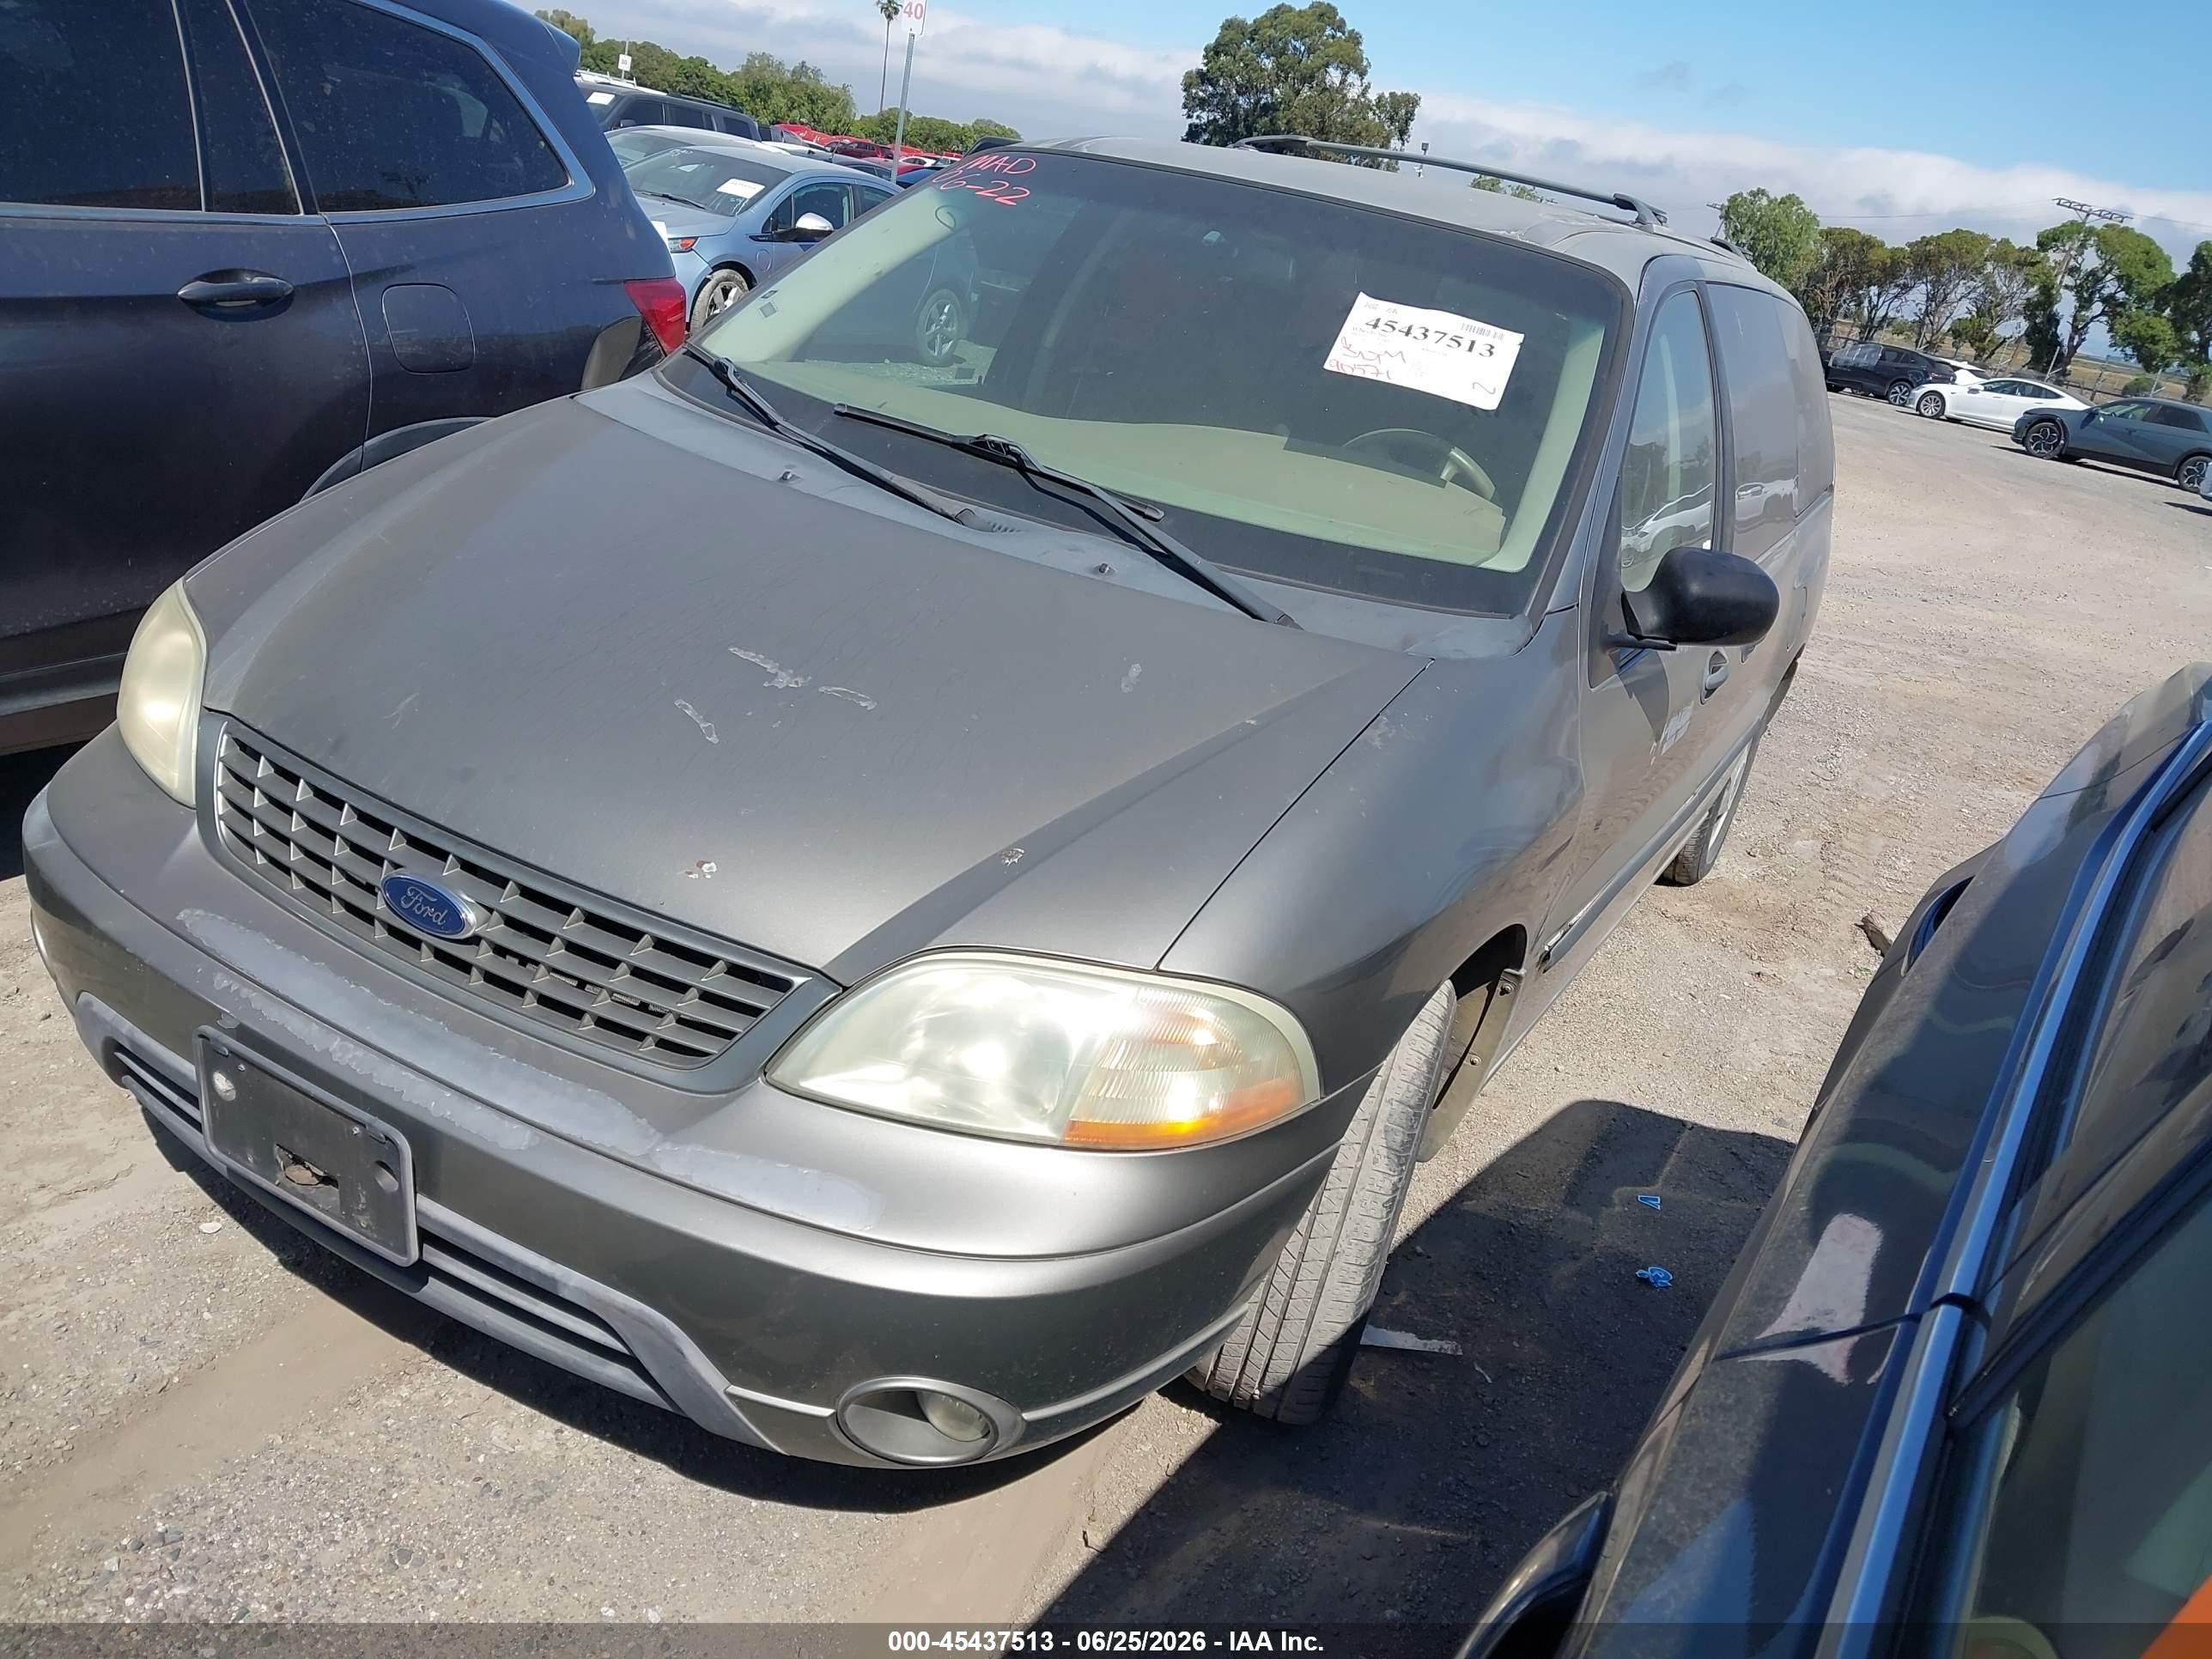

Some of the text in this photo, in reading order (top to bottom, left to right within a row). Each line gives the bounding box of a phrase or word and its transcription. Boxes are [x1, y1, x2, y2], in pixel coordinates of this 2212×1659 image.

[903, 2, 924, 20] 40
[1365, 318, 1496, 357] 45437513
[400, 886, 448, 928] Ford
